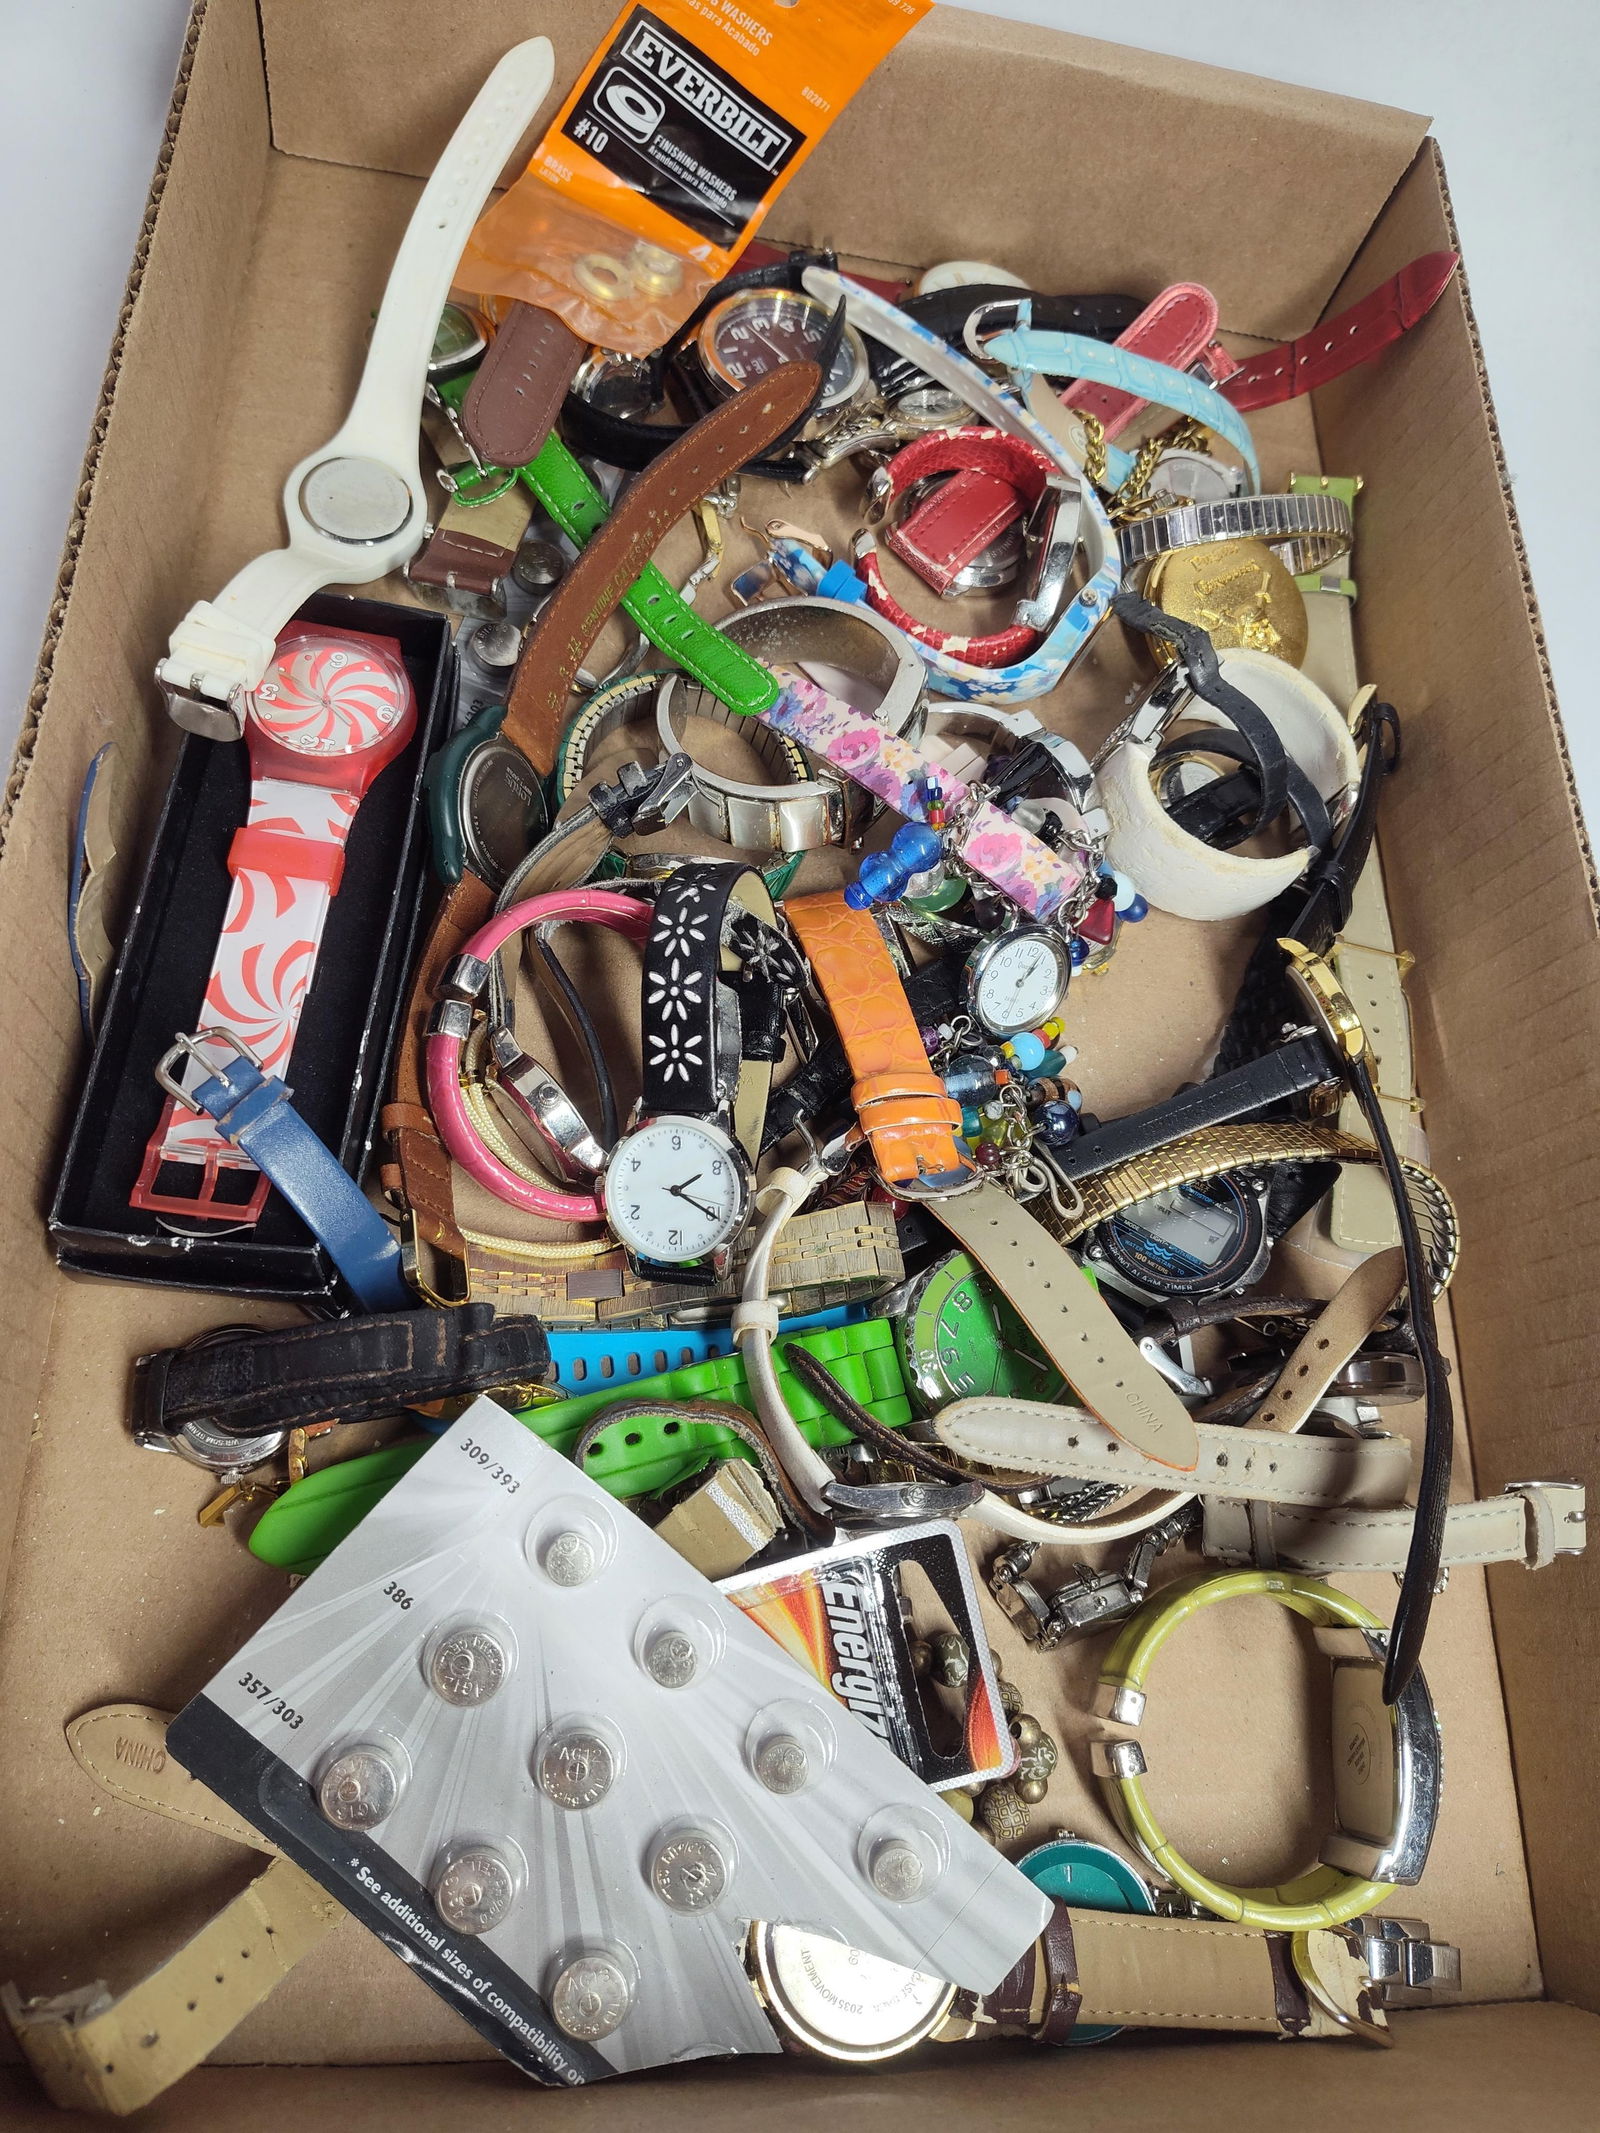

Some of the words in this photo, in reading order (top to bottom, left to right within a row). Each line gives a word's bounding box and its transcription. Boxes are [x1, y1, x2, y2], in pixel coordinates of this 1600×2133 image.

[700, 7, 722, 26] para
[722, 17, 761, 57] Acabado
[721, 1, 773, 46] WASHERS
[631, 30, 782, 161] EVERBILT
[801, 86, 831, 113] 802871
[573, 118, 609, 154] #10
[543, 155, 574, 183] BRASS
[648, 145, 682, 175] Arandelas
[681, 170, 700, 189] para
[699, 183, 728, 209] Acabado
[654, 135, 698, 172] FINISHING
[698, 164, 738, 201] WASHERS
[730, 326, 750, 341] 2
[258, 683, 279, 701] 3
[505, 772, 531, 806] LORUS
[671, 1135, 682, 1151] 6
[630, 1157, 641, 1172] 4
[711, 1160, 722, 1175] 8
[630, 1204, 641, 1221] 2
[668, 1229, 684, 1246] 12
[1123, 1219, 1140, 1231] MODE
[1149, 1233, 1167, 1245] LIGHT
[1134, 1251, 1147, 1263] 100
[1148, 1260, 1170, 1275] METERS
[1145, 1250, 1176, 1270] RESISTANT
[1177, 1267, 1185, 1275] TO
[1163, 1282, 1194, 1291] TIMER
[952, 1290, 973, 1313] 8
[940, 1318, 959, 1339] 7
[940, 1347, 960, 1367] 6
[953, 1371, 976, 1394] 5
[1126, 1392, 1163, 1433] CHINA
[460, 1438, 521, 1494] 309/393
[383, 1581, 415, 1611] 386
[238, 1672, 304, 1730] 357/303
[115, 1736, 167, 1775] CHINA
[558, 1746, 602, 1763] AG12
[356, 1866, 382, 1895] See
[380, 1891, 446, 1951] additional
[441, 1947, 474, 1980] sizes
[472, 1977, 493, 1994] of
[487, 1990, 569, 2073] compatibility
[801, 1949, 838, 2006] MOVEMENT
[837, 1998, 864, 2015] 2035
